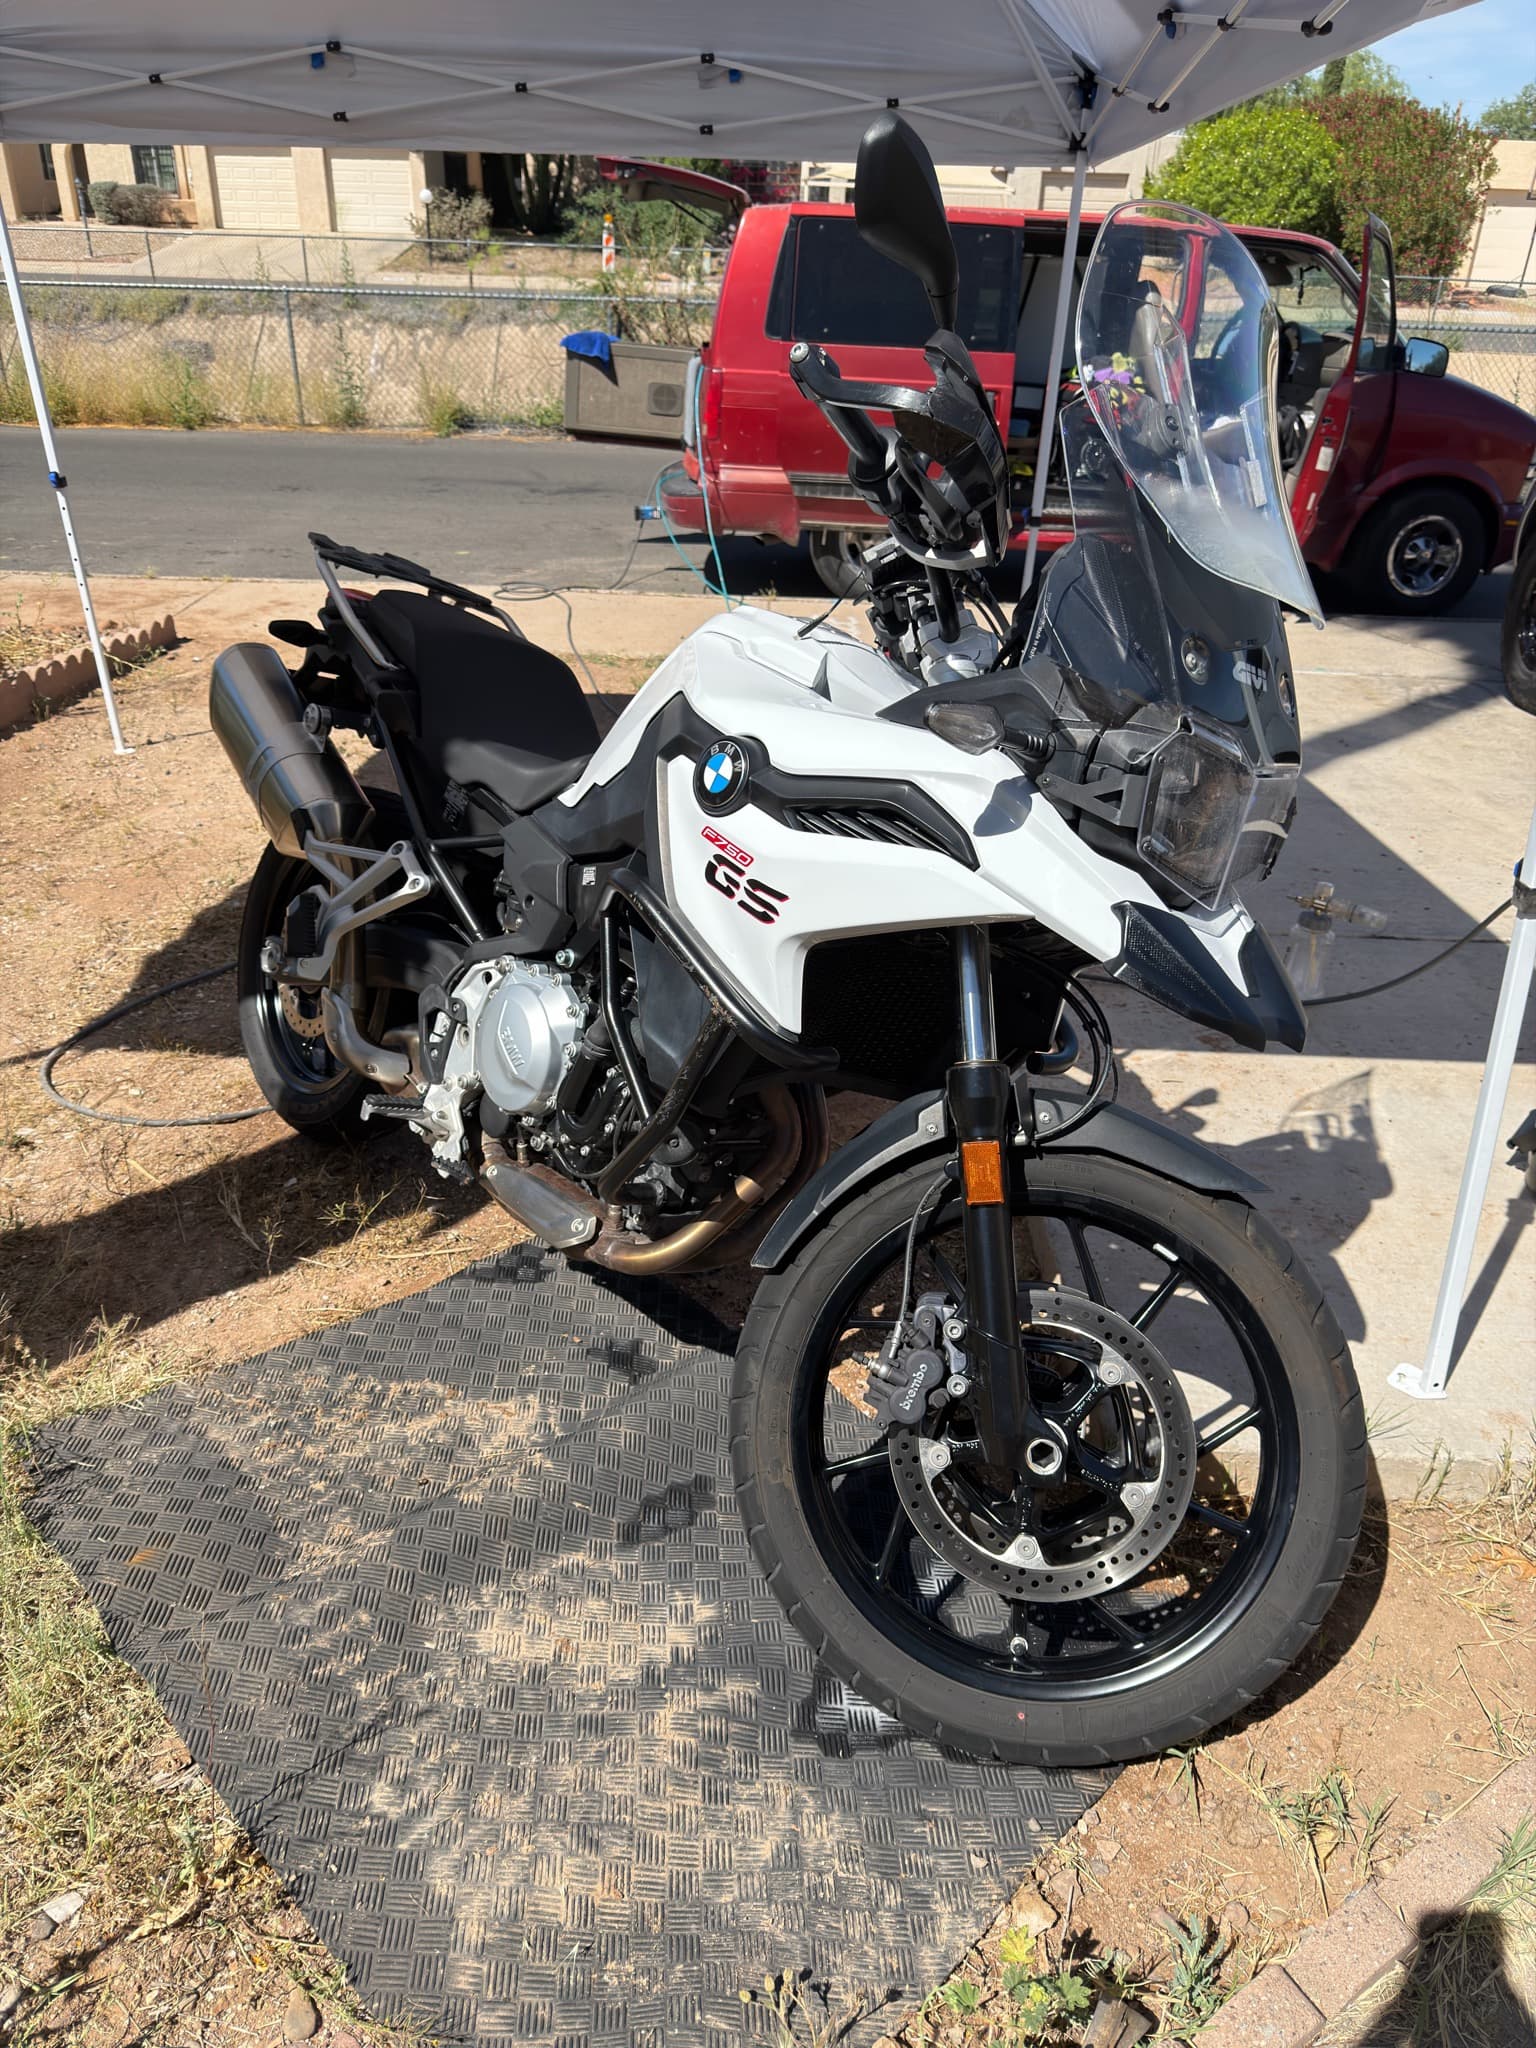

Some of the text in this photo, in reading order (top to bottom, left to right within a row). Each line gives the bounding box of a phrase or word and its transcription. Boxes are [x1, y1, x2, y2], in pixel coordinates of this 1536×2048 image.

[710, 743, 742, 772] BMW
[702, 828, 753, 865] F750
[705, 853, 790, 924] GS
[500, 1026, 525, 1068] BMW
[899, 1363, 928, 1411] brembo
